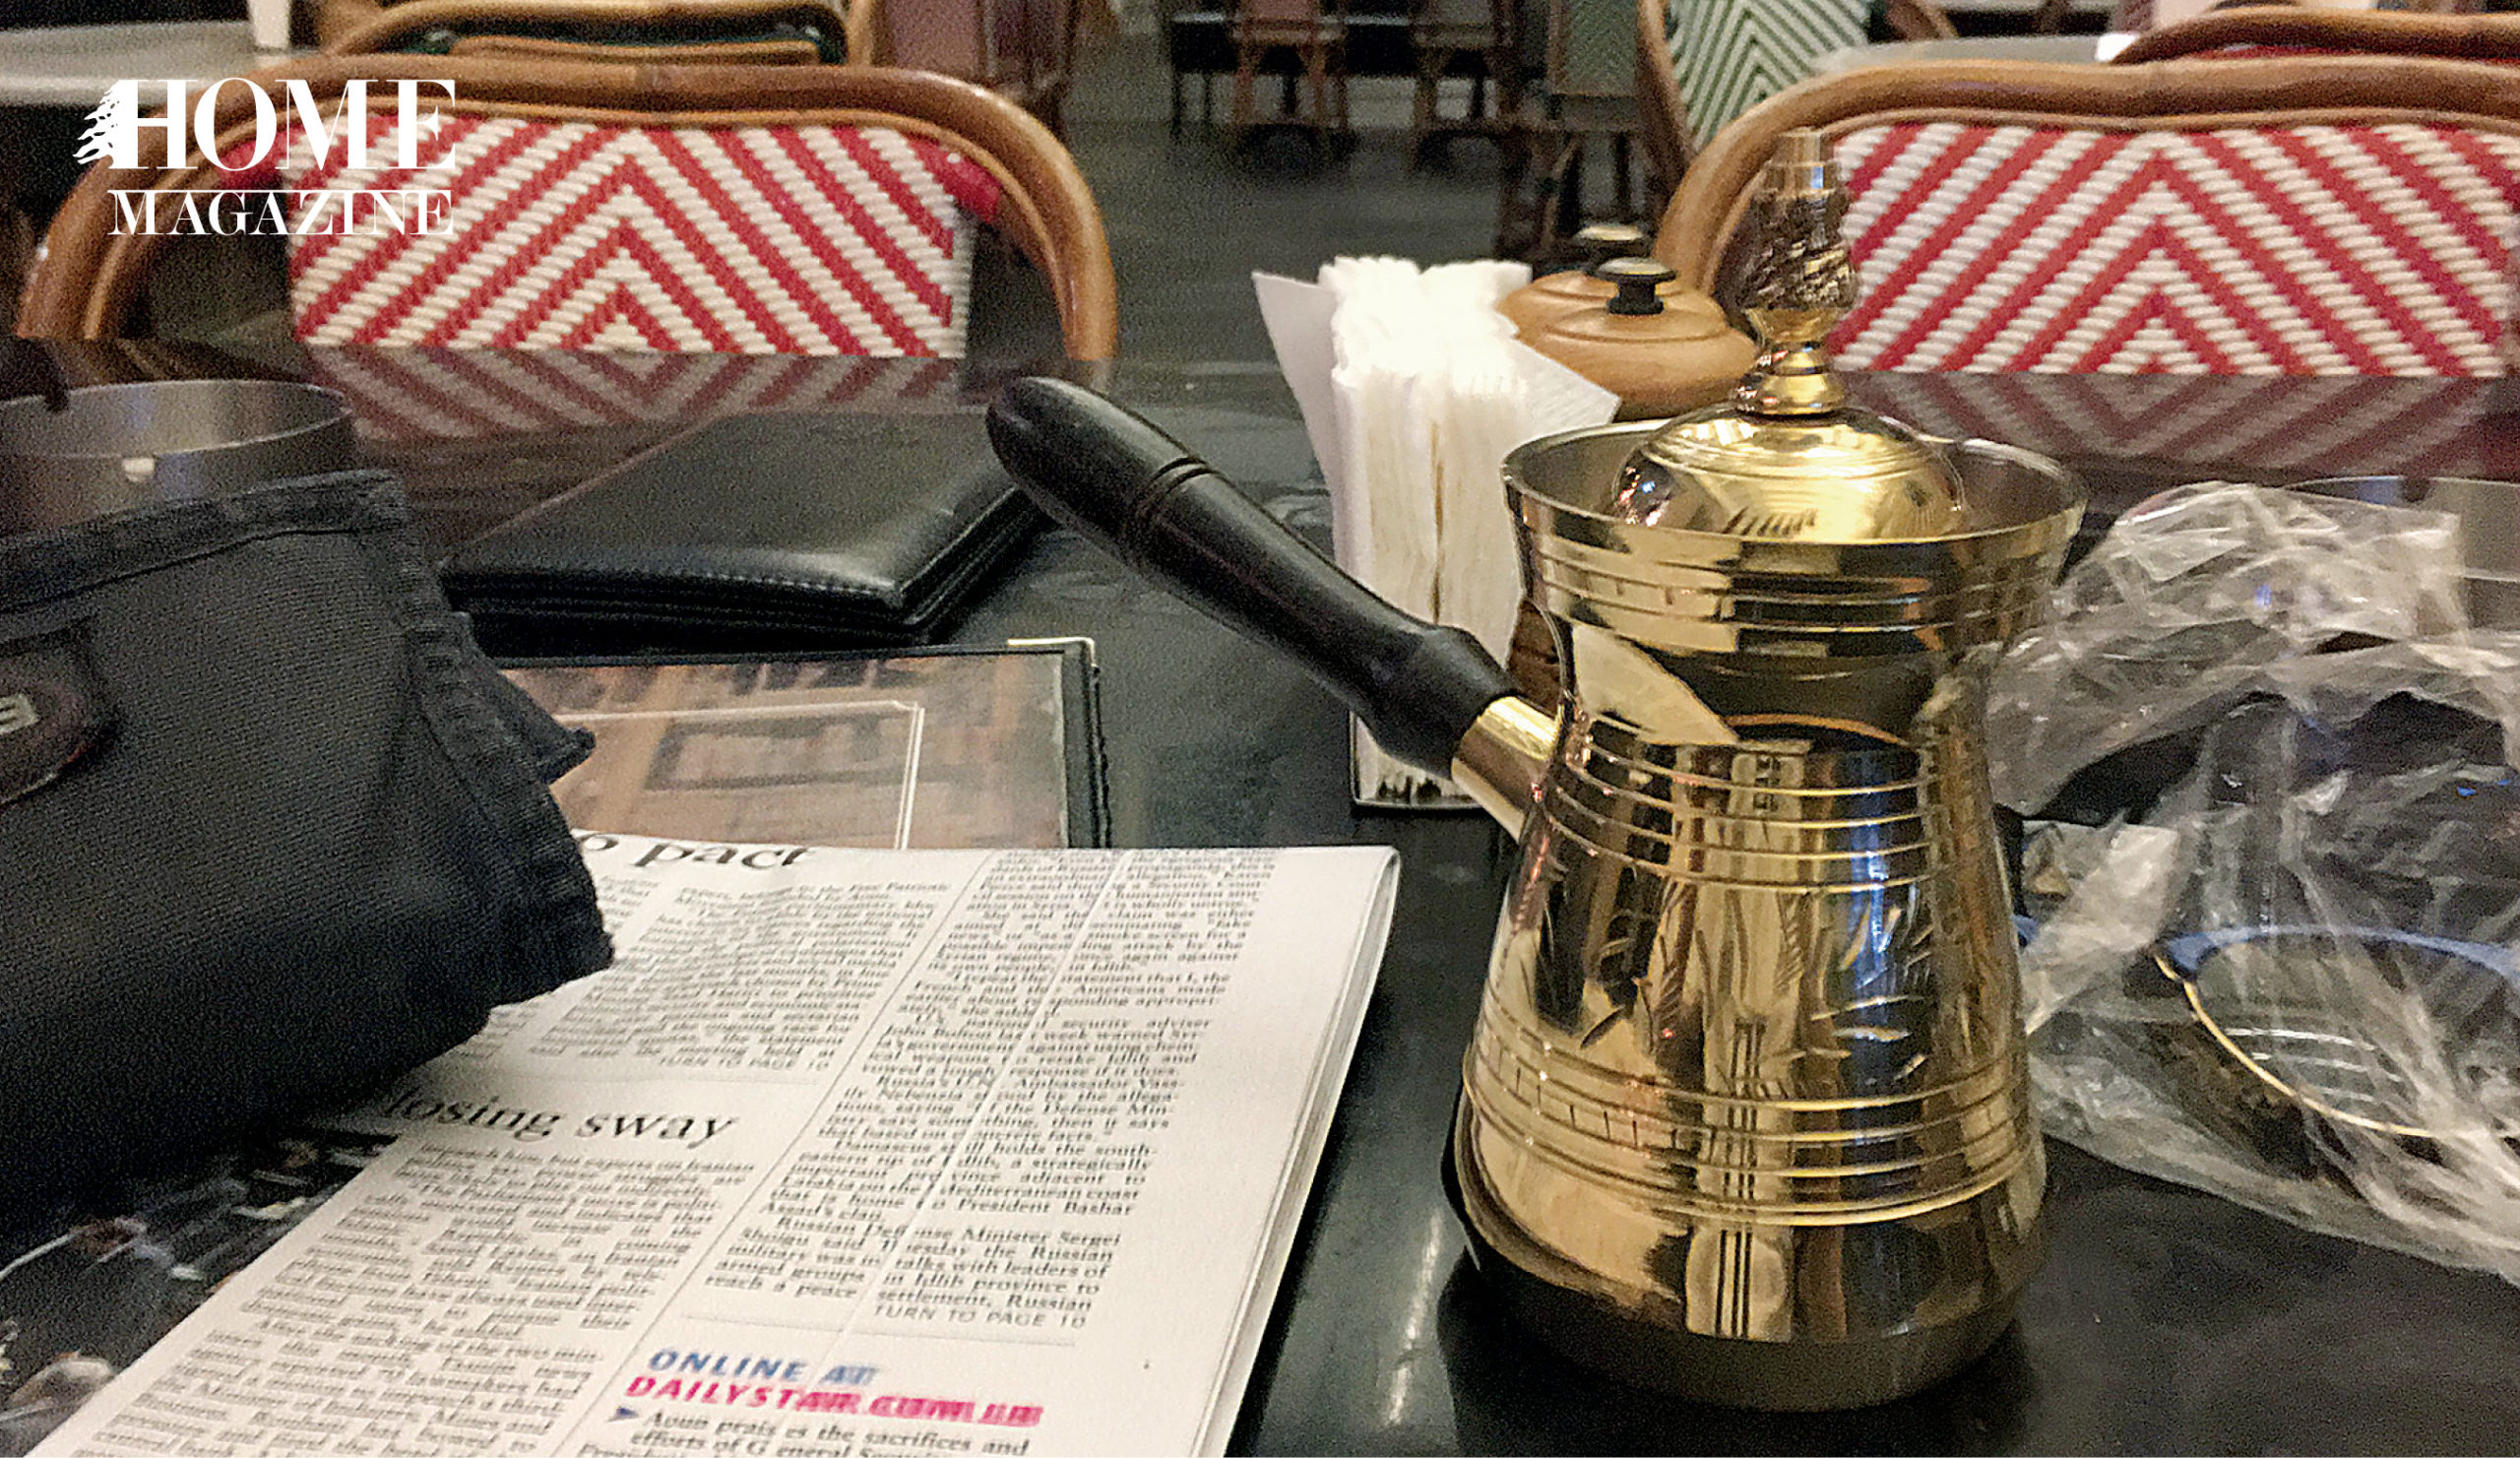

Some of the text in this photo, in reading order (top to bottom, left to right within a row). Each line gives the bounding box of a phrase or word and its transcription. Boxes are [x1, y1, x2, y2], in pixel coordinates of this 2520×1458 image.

[630, 842, 815, 870] pact
[384, 1086, 737, 1149] losing sway
[1030, 1244, 1112, 1263] Russian
[874, 1304, 936, 1322] TURN
[948, 1307, 976, 1323] TO
[985, 1309, 1046, 1327] PAGE
[1004, 1293, 1091, 1313] Russian
[648, 1348, 806, 1381] ONLINE
[817, 1425, 854, 1442] the
[862, 1430, 973, 1451] sacrifices
[982, 1438, 1030, 1457] and
